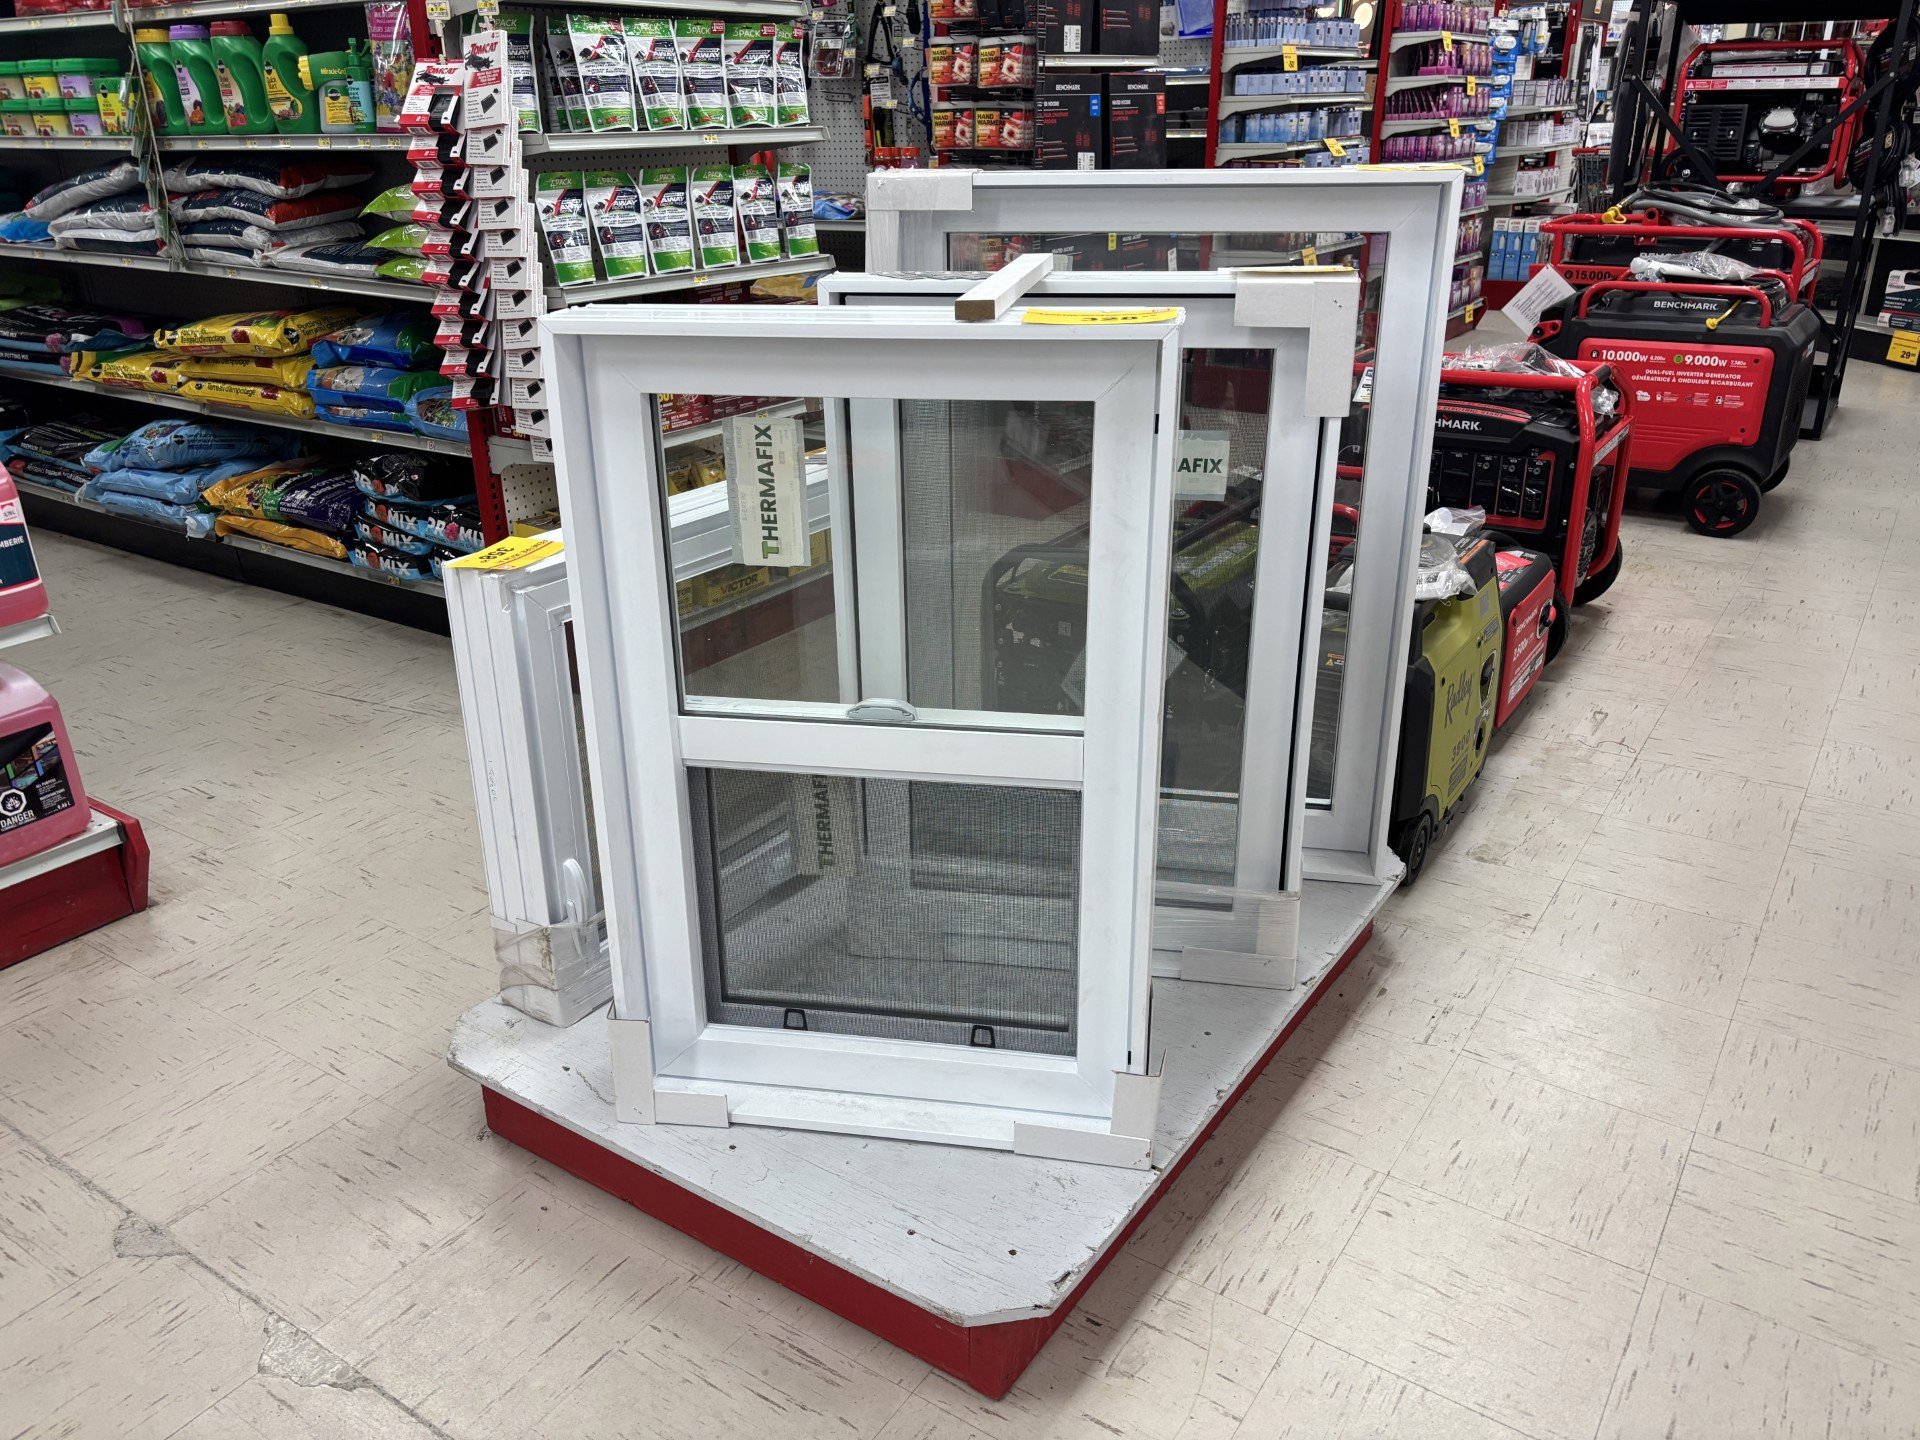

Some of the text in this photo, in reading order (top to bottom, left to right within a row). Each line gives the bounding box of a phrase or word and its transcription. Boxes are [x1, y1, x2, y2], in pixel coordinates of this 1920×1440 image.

[471, 42, 498, 56] TOMCAT
[425, 65, 458, 74] TOMCAT
[1653, 300, 1719, 310] BENCHMARK
[297, 318, 323, 330] Potting
[301, 325, 326, 337] Terreau
[1645, 368, 1675, 376] DUAL-FUEL
[1676, 370, 1704, 378] INVERTER
[1711, 379, 1753, 387] BICARBURANT
[1177, 457, 1224, 474] AFIX
[753, 423, 780, 560] THERMAFIX
[0, 809, 35, 828] DANGER
